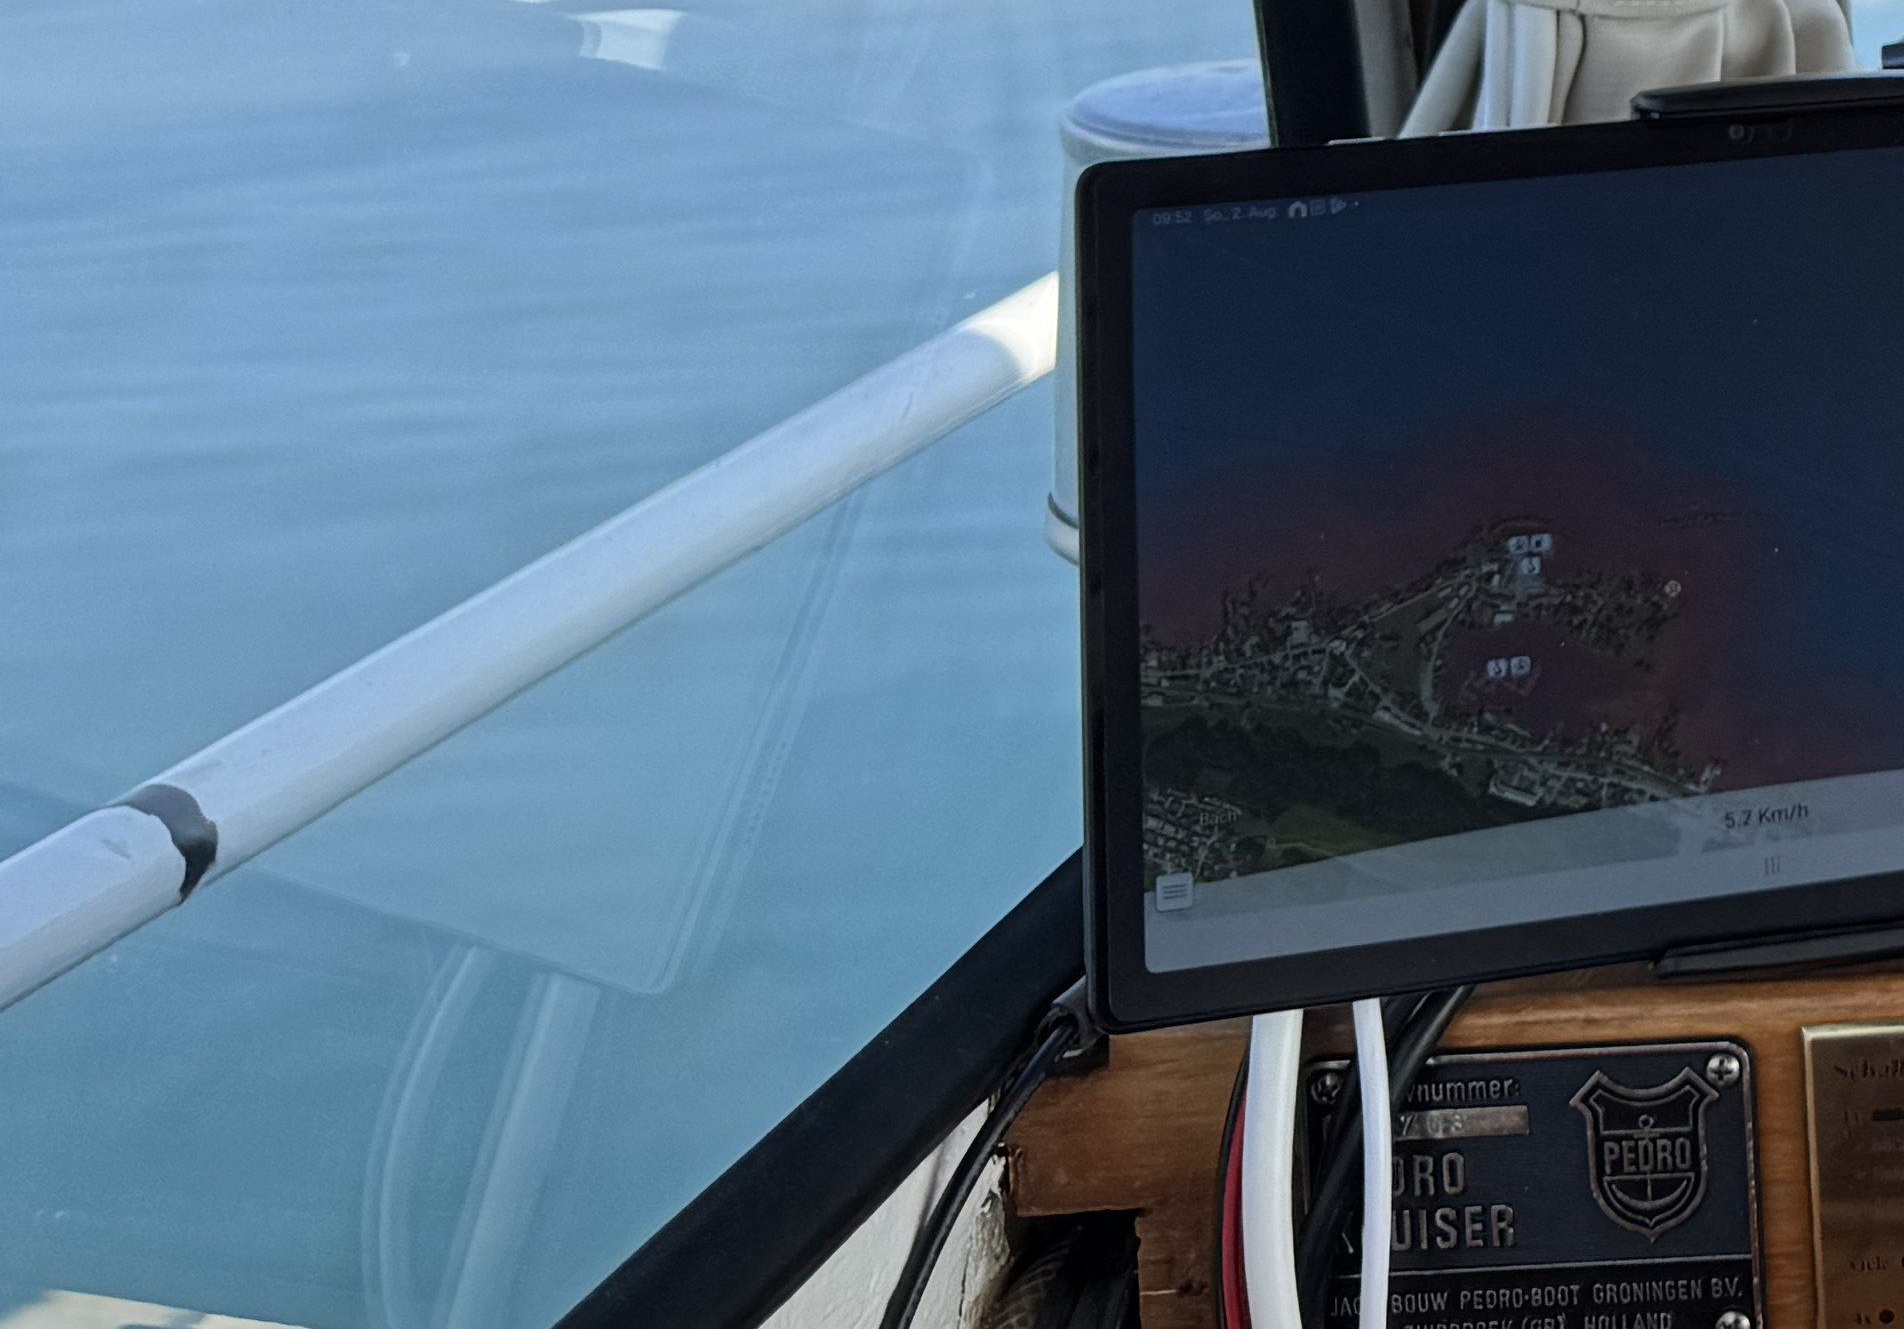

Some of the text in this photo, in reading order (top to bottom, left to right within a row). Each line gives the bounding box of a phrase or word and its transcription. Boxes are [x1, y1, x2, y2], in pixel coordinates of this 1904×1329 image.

[1758, 801, 1809, 825] Km/h
[1603, 1137, 1692, 1175] PEDRO
[1391, 1203, 1516, 1252] UISER
[1592, 1278, 1703, 1305] GRONINGEN
